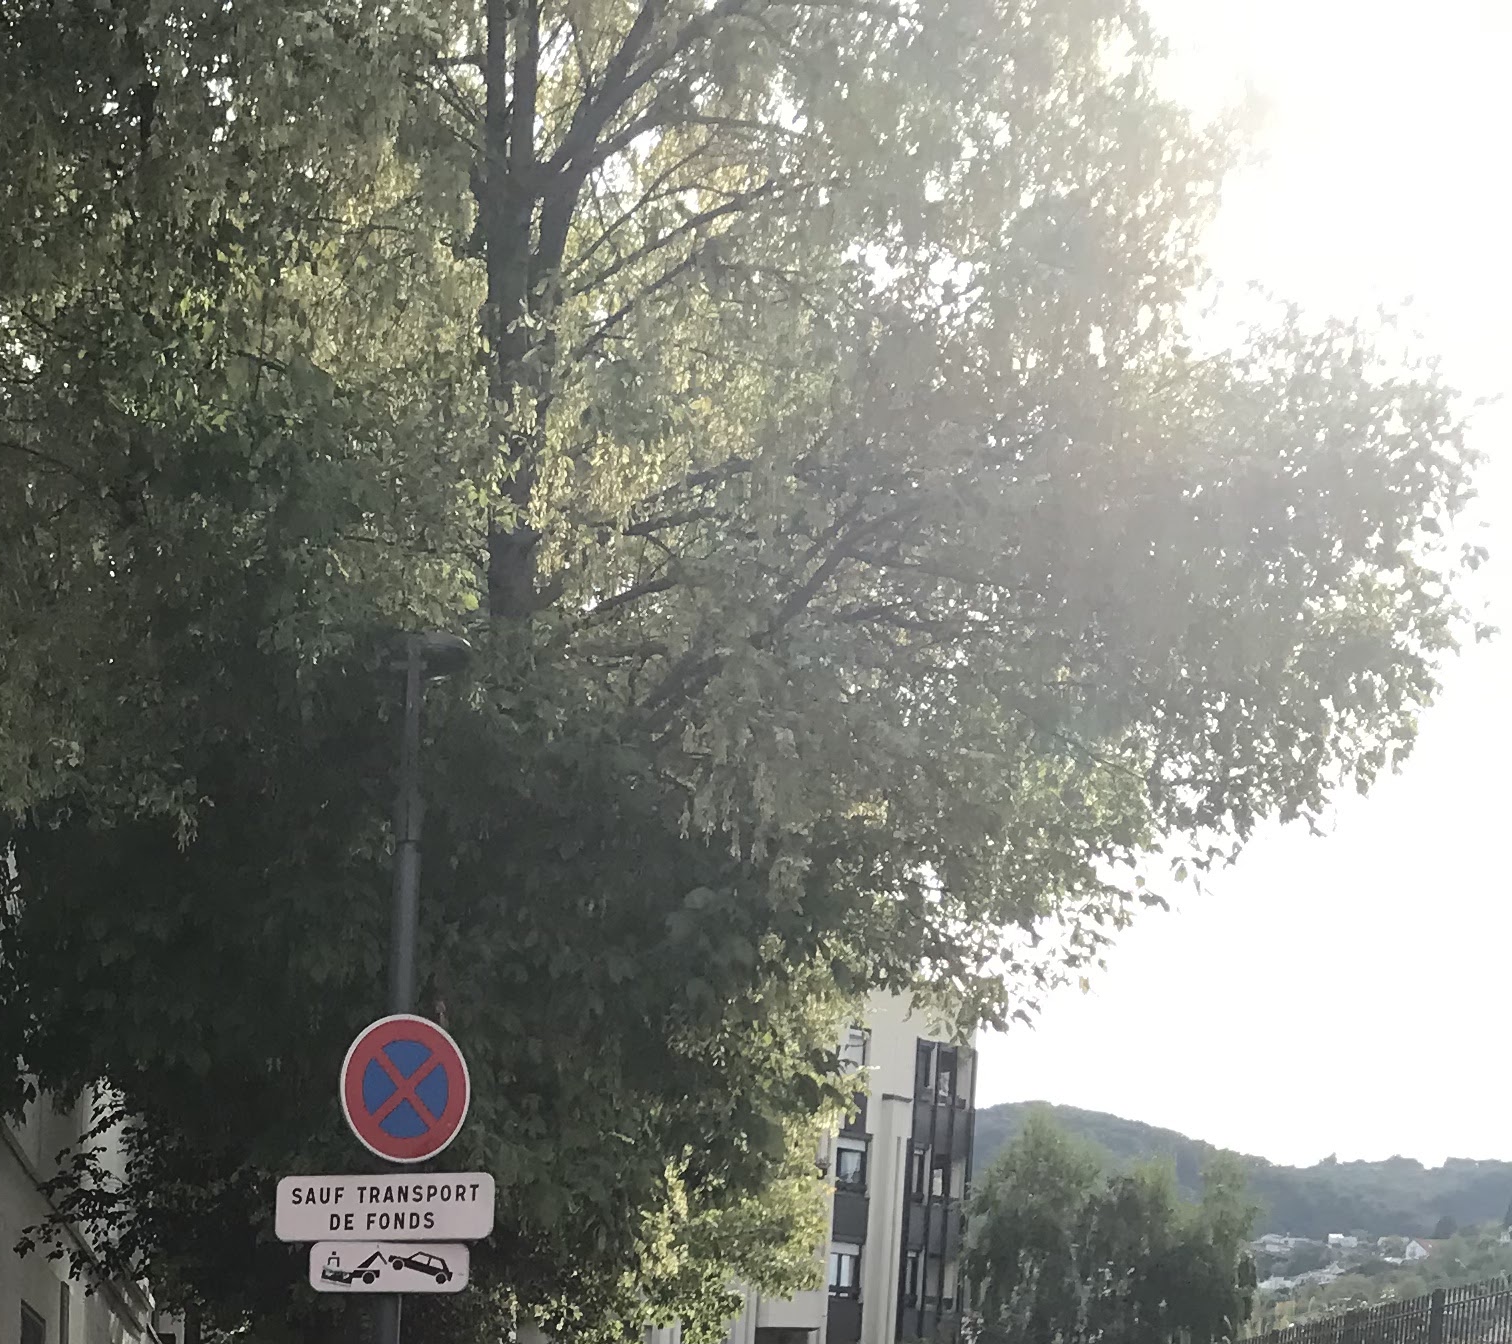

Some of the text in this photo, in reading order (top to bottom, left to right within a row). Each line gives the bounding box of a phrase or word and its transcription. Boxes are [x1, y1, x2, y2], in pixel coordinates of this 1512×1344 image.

[291, 1184, 480, 1205] SAUF TRANSPORT
[329, 1212, 435, 1231] DE FONDS
